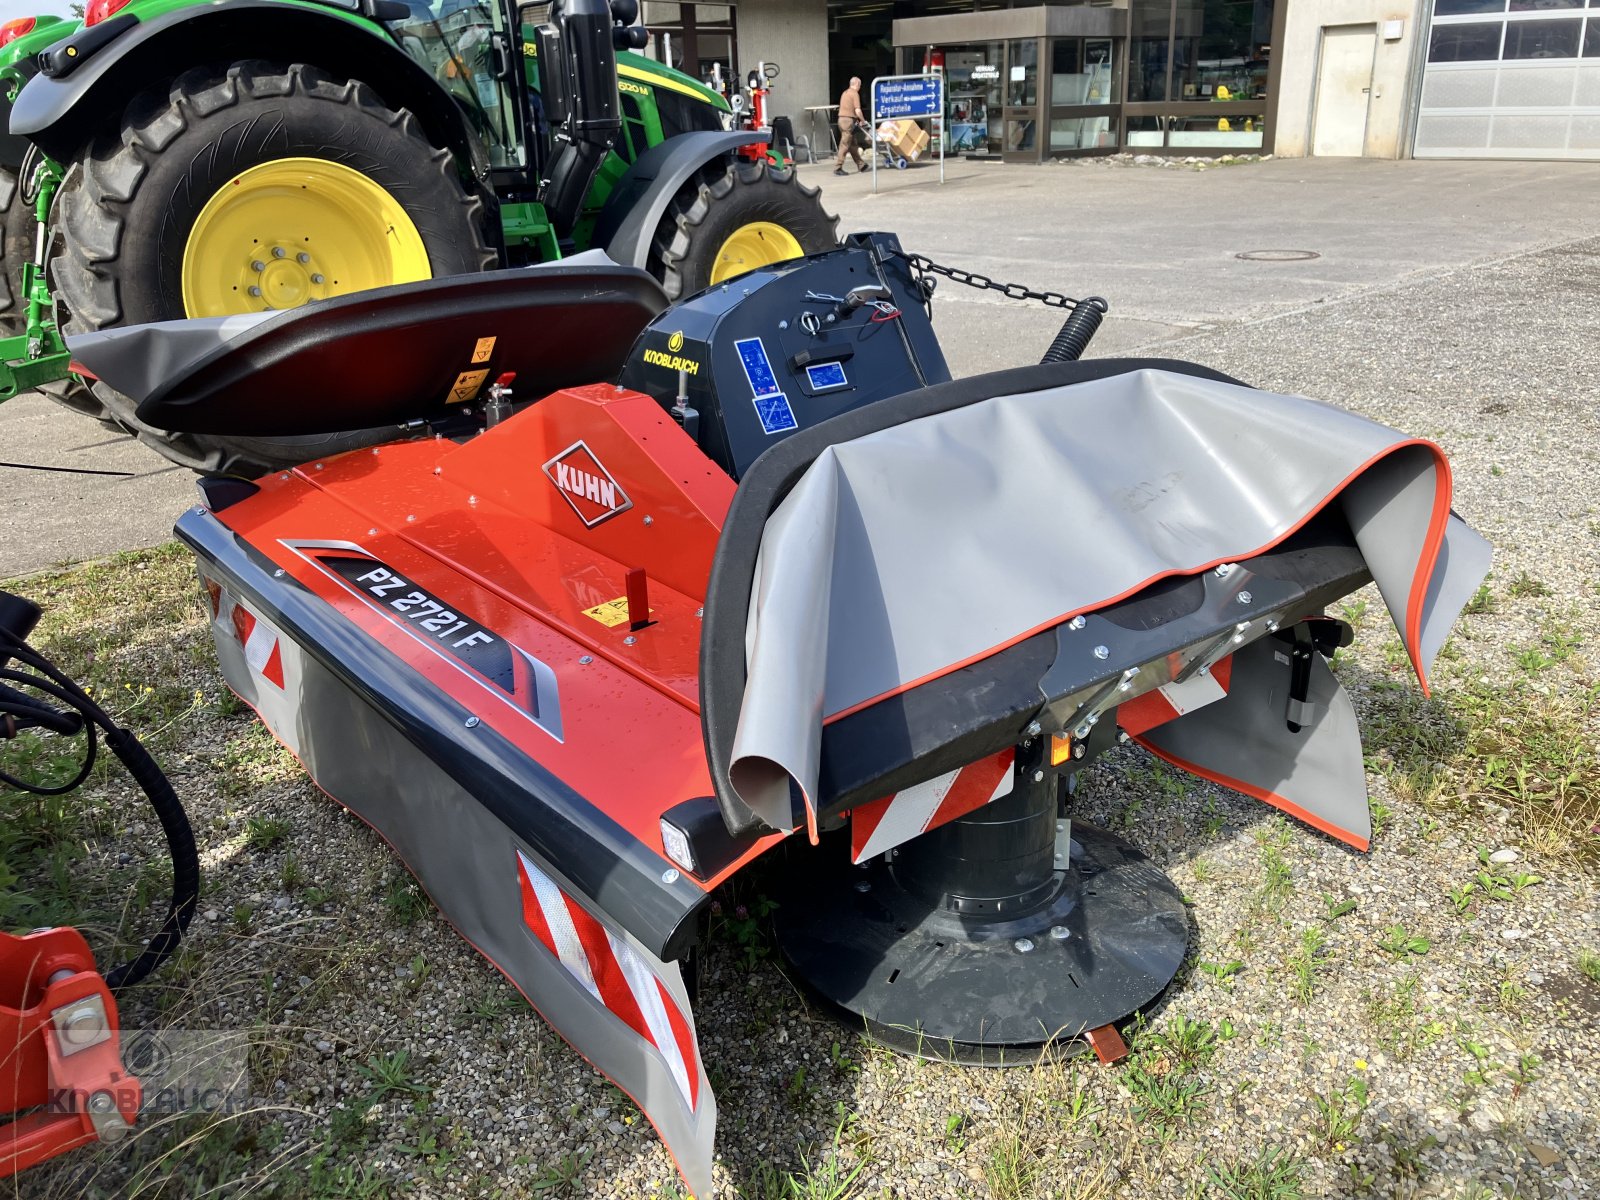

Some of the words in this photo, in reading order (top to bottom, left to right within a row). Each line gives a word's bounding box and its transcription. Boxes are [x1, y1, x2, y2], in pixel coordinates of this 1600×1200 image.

[880, 103, 911, 114] Ersatzteile
[881, 93, 903, 103] Verkauf
[643, 348, 700, 376] KNOBLAUCH
[556, 460, 616, 511] KUHN
[355, 567, 407, 598] PZ
[389, 591, 469, 639] 2721
[451, 630, 494, 648] F
